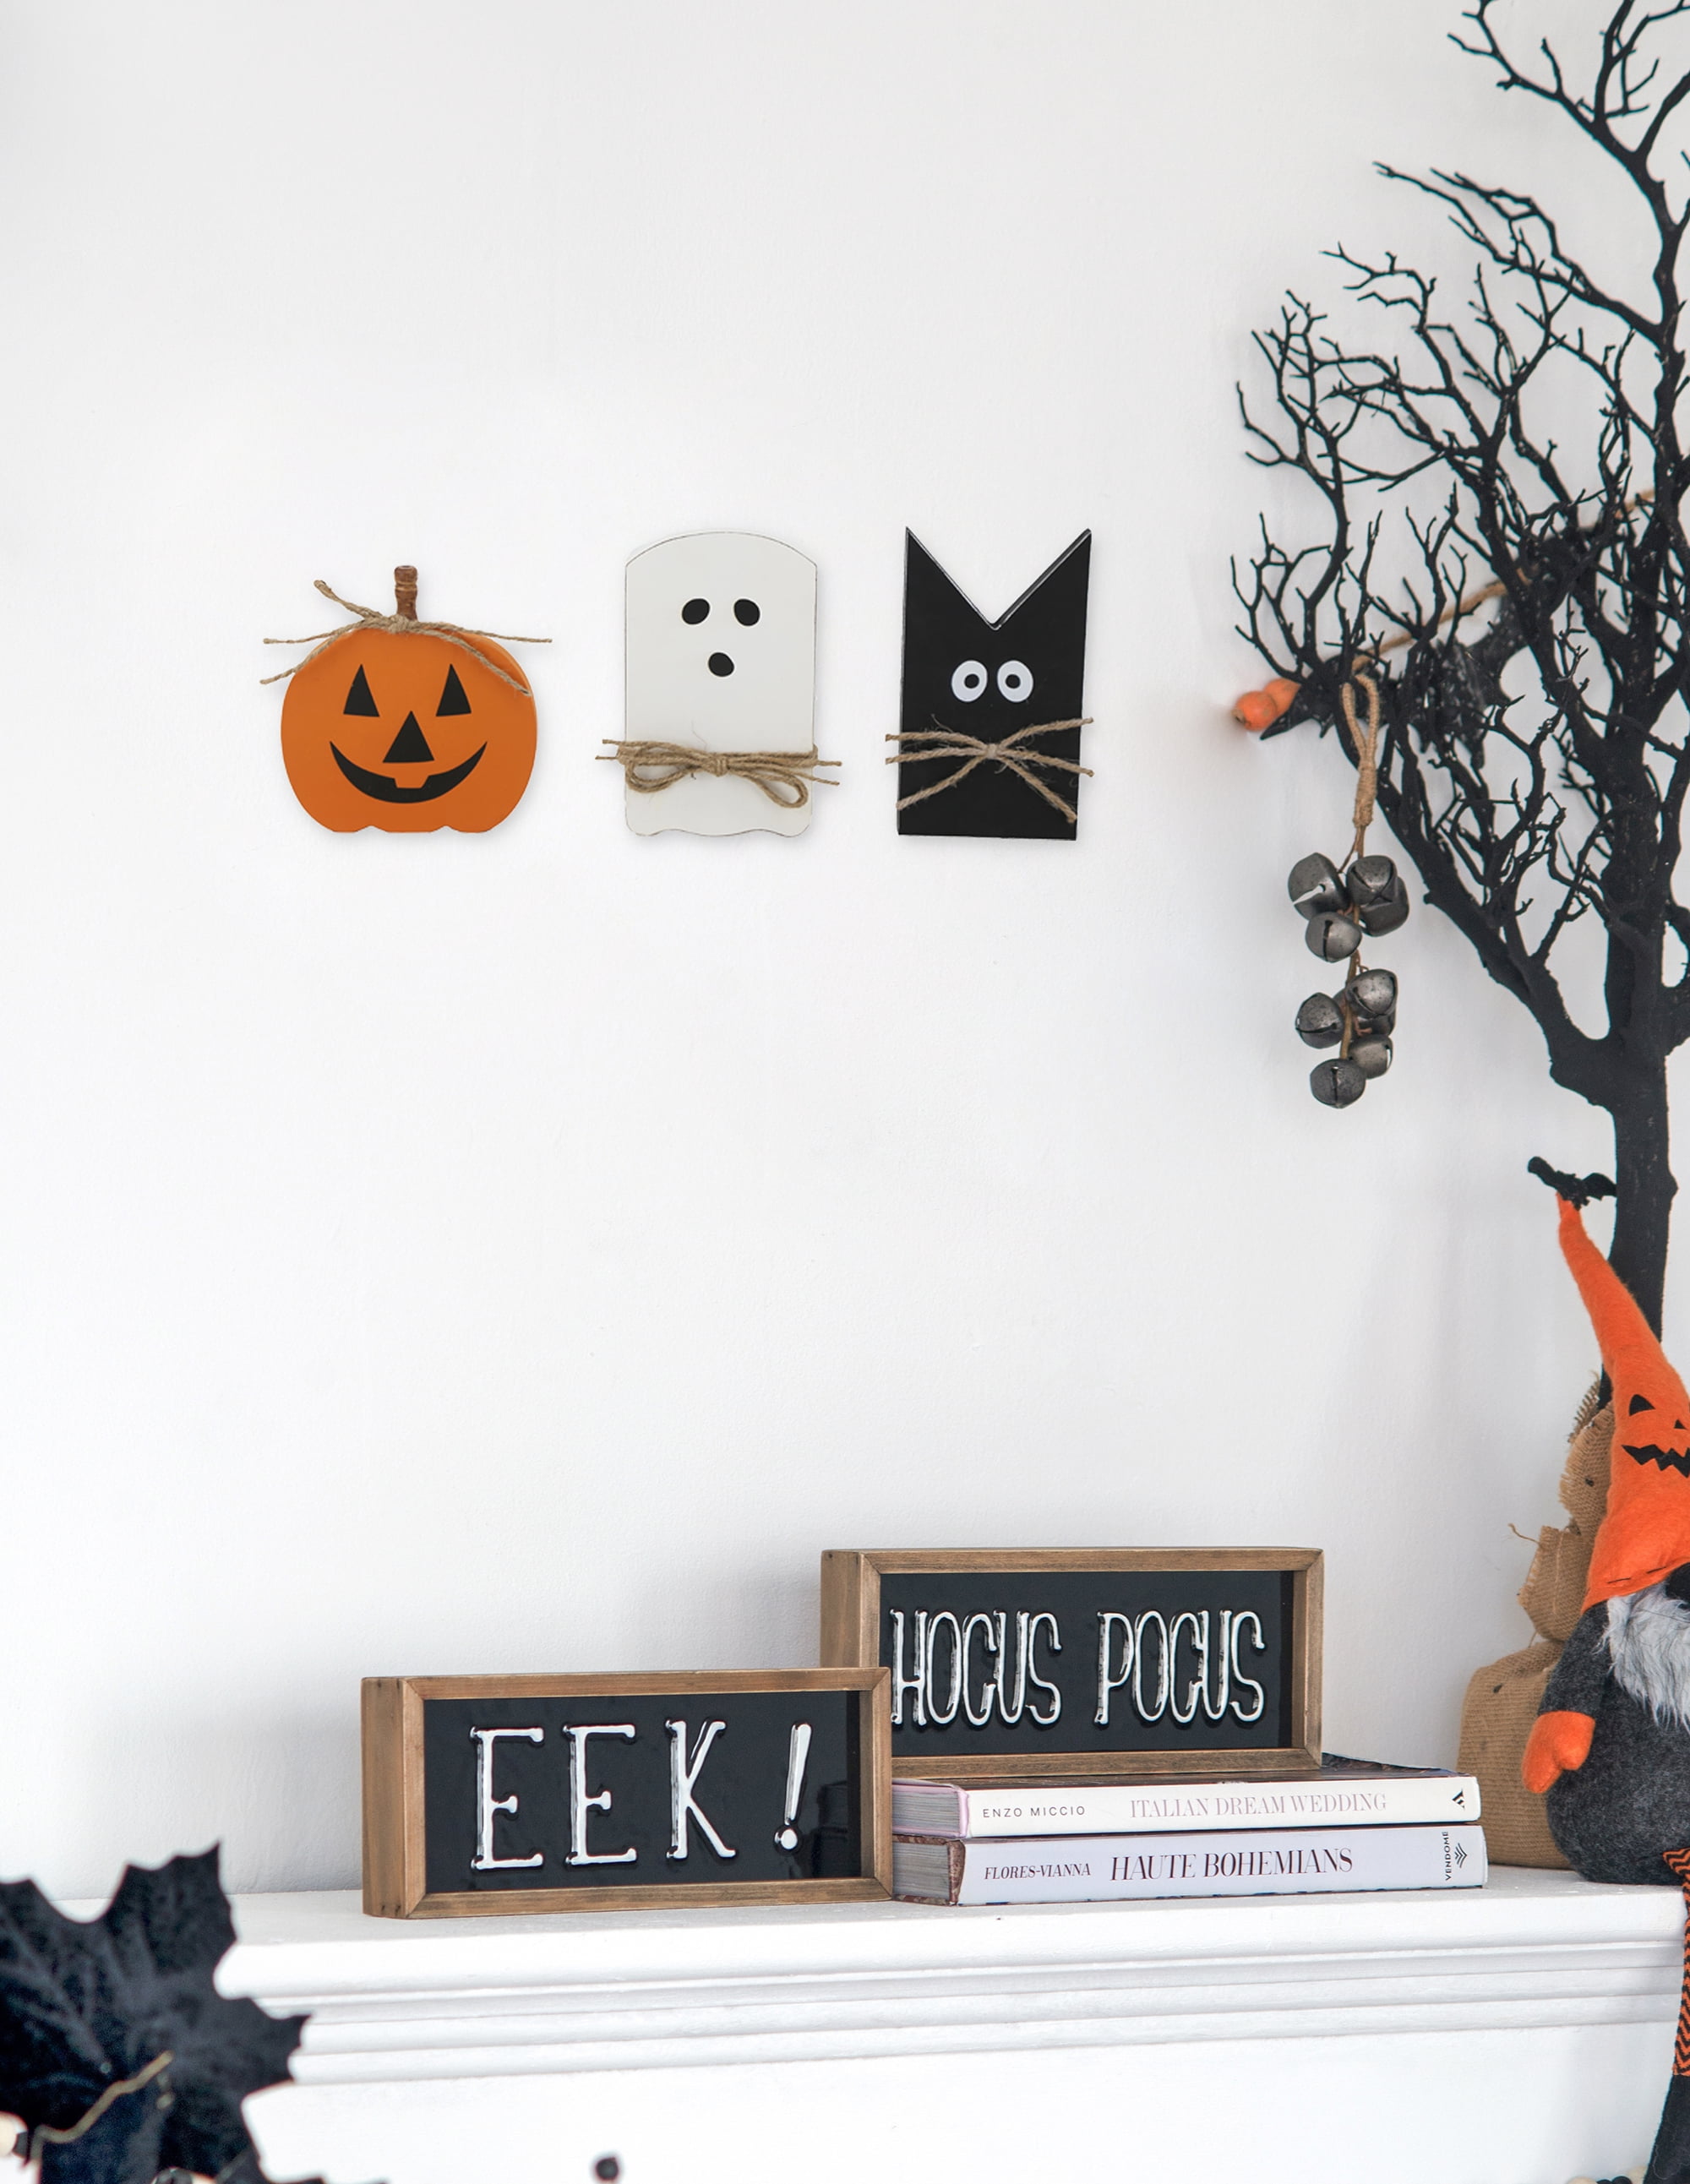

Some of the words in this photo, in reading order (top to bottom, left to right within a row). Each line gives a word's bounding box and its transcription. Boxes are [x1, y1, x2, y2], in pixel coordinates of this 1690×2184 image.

[890, 1609, 1062, 1725] HOCUS
[1093, 1609, 1266, 1724] POCUS
[982, 1807, 1022, 1818] ENZO
[1029, 1805, 1086, 1816] MICCIO
[1130, 1798, 1209, 1818] ITALIAN
[1216, 1795, 1285, 1816] DREAM
[1289, 1793, 1387, 1813] WEDDING
[1109, 1854, 1197, 1881] HAUTE
[1203, 1848, 1354, 1877] BOHEMIANS
[1442, 1831, 1453, 1882] VENDOME
[984, 1863, 1092, 1880] FLORES-VIANNA
